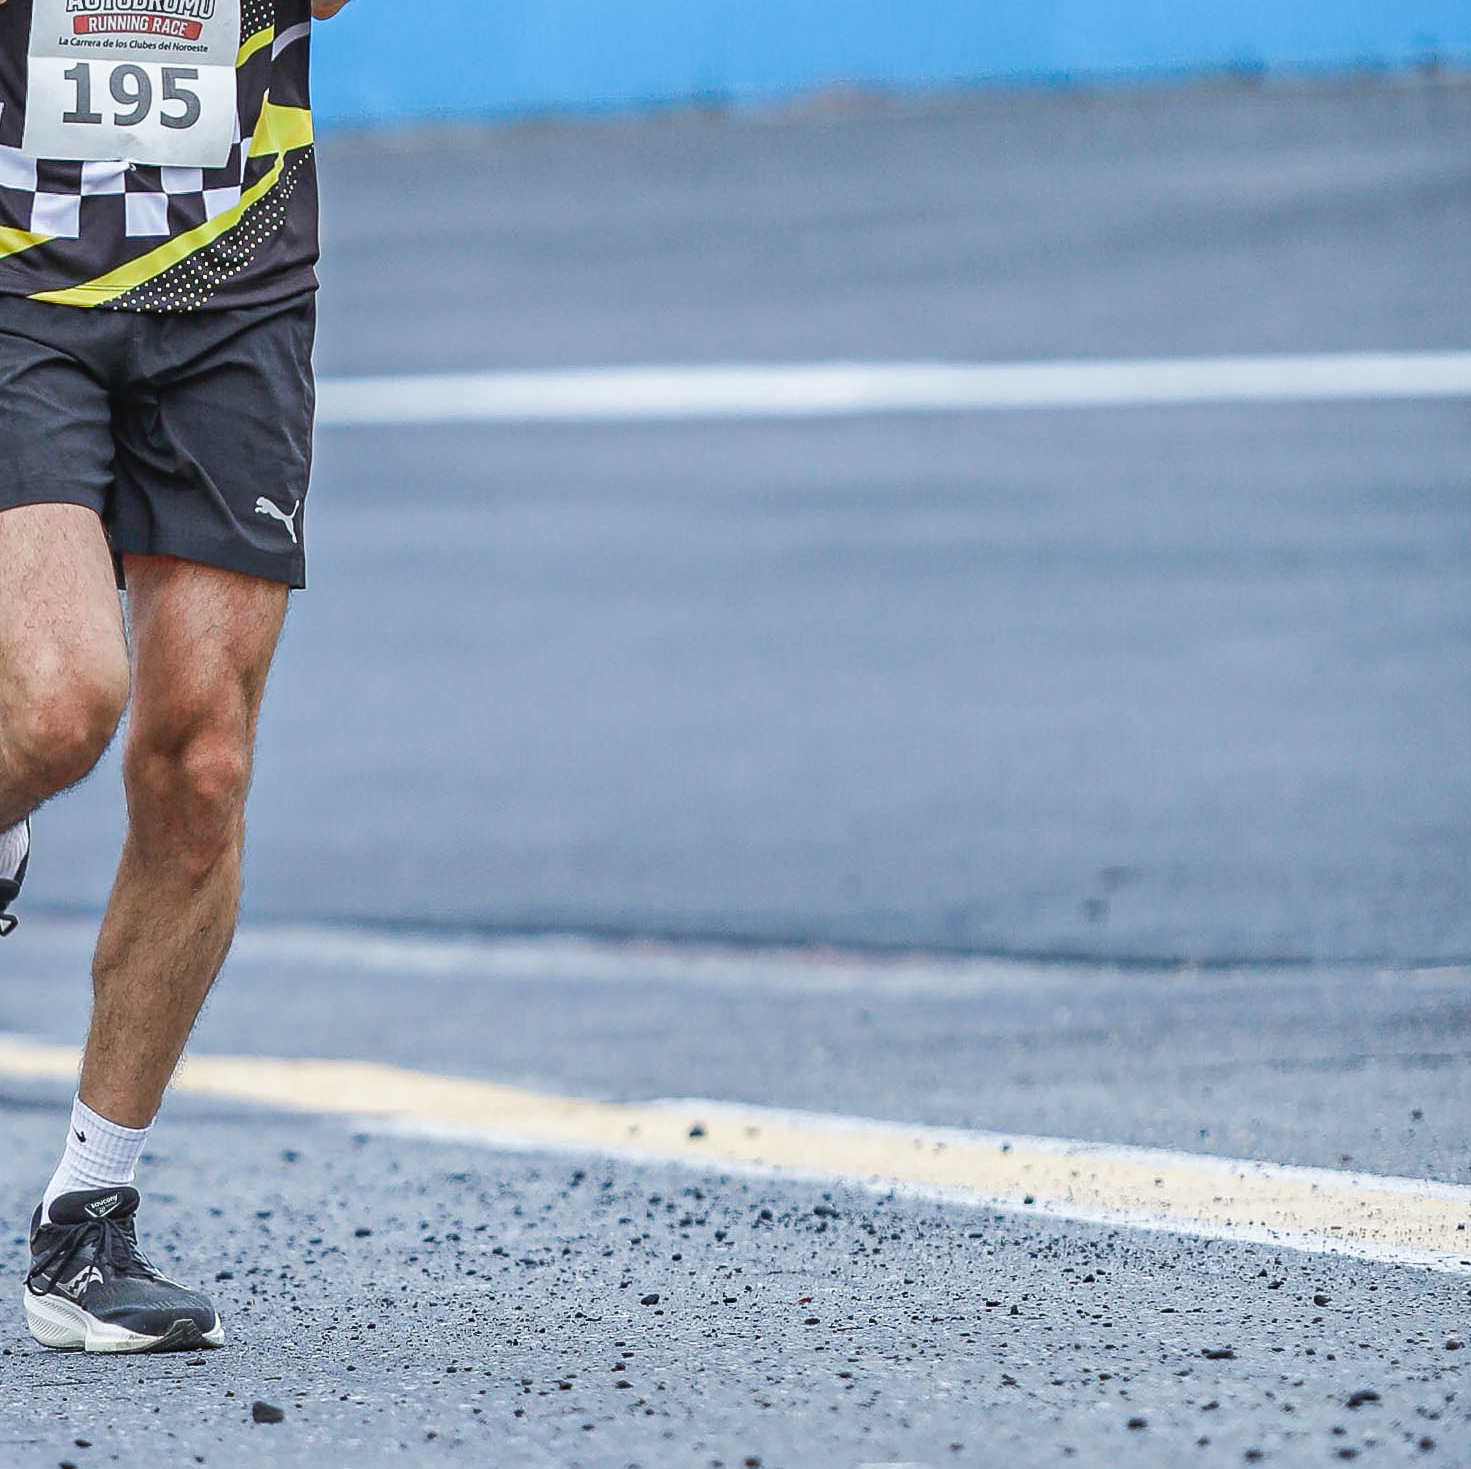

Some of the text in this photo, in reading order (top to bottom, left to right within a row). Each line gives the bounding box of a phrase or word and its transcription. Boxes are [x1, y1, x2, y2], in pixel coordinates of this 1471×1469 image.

[88, 15, 188, 36] RUNNING RACE
[58, 36, 209, 53] La Carrera de los Clubes del Noroeste
[62, 62, 202, 130] 195
